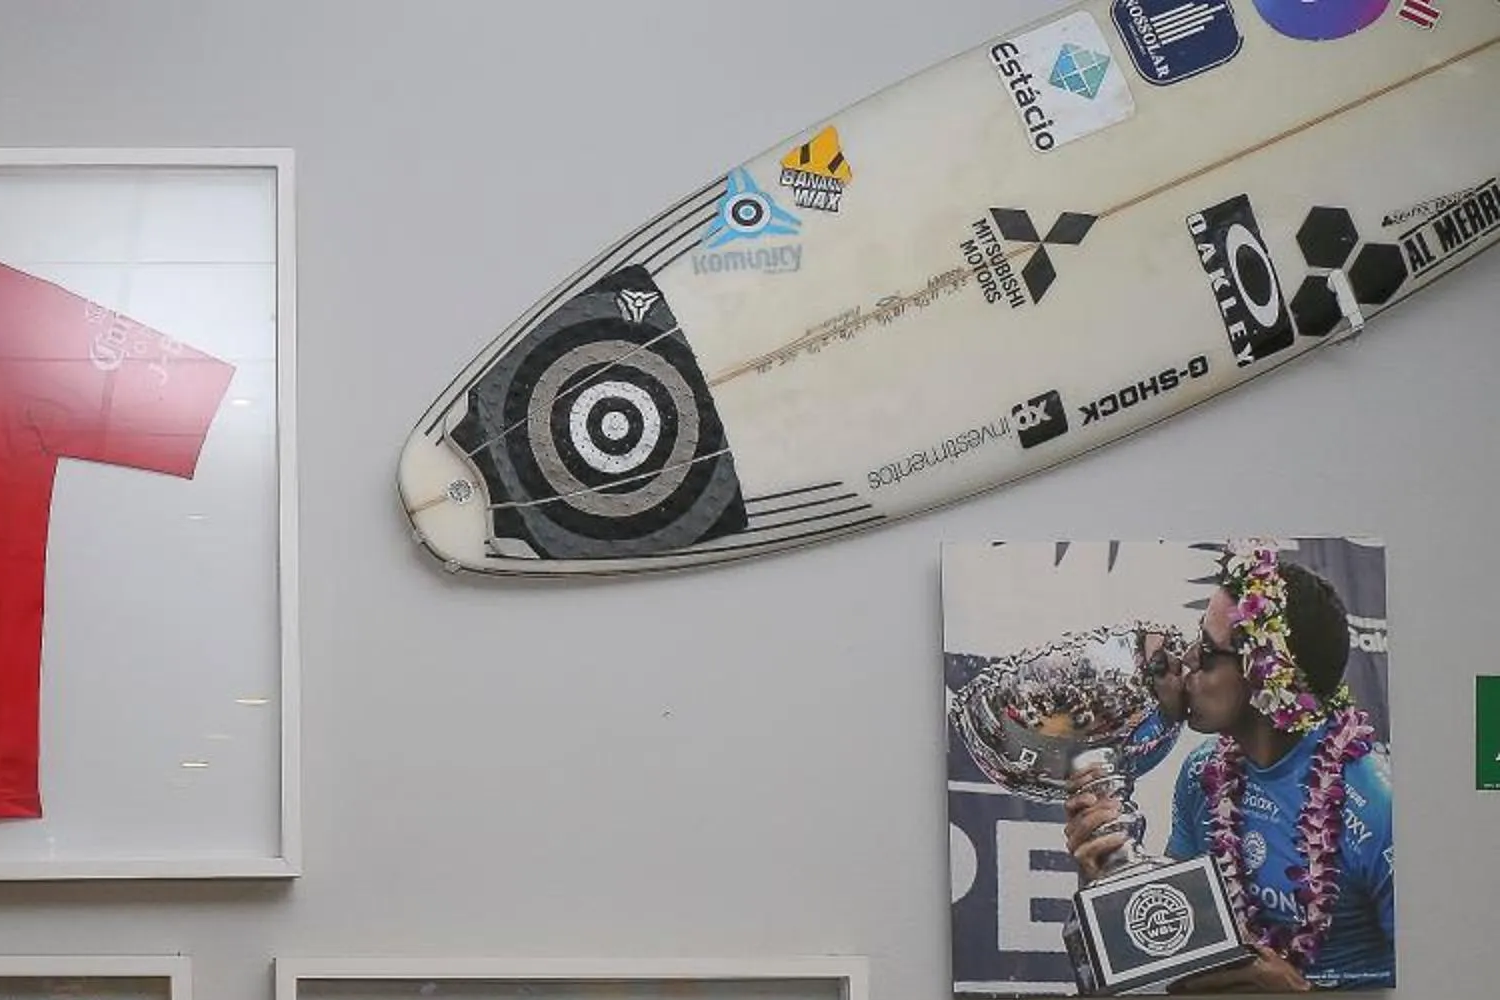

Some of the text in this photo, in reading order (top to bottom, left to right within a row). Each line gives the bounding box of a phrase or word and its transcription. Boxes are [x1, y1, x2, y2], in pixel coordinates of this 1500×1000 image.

[991, 42, 1054, 151] Estácio
[795, 188, 841, 211] WAX
[960, 239, 1002, 304] MOTORS
[972, 218, 1026, 308] MITSUBISHI
[1403, 232, 1437, 273] AL
[1187, 212, 1255, 366] OAKLEY
[1079, 355, 1209, 426] G-SHOCK
[868, 417, 1012, 488] investimentos
